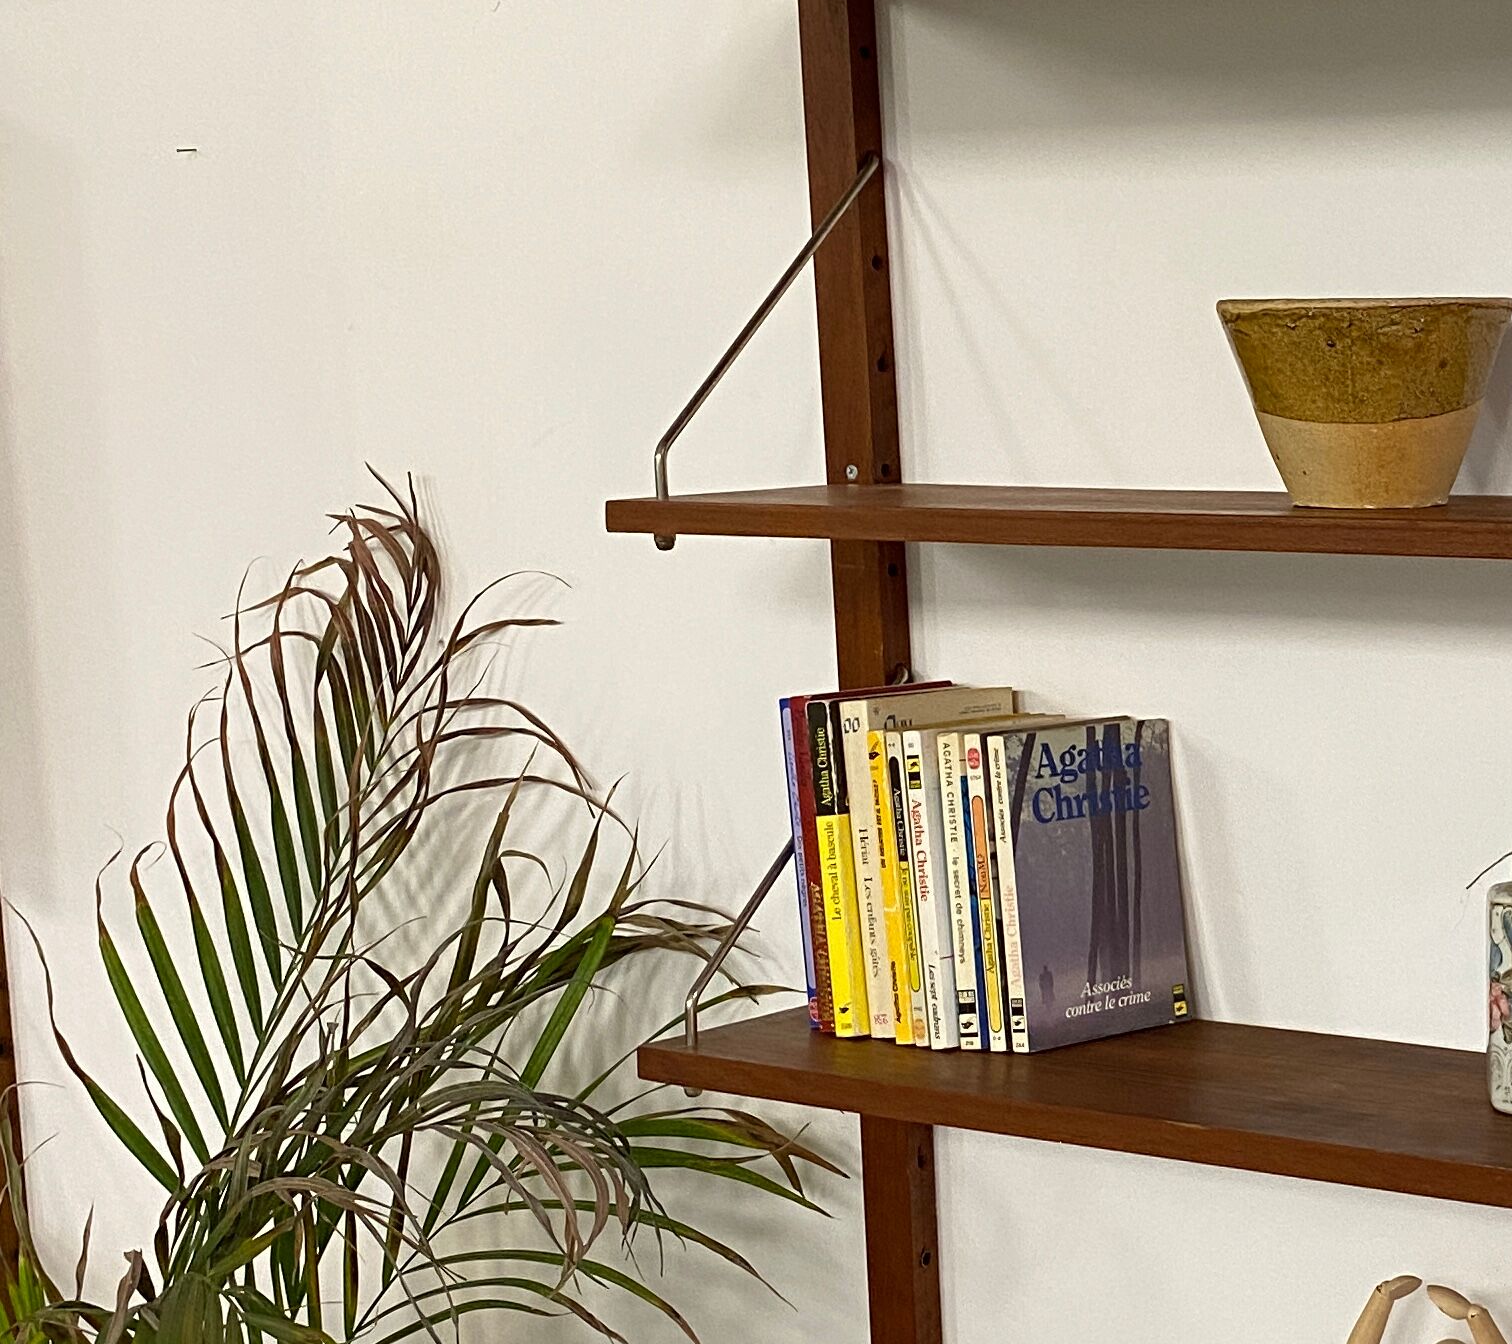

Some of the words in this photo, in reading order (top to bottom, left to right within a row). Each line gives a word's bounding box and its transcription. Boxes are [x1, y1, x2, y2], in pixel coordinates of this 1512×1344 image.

[817, 727, 829, 769] Christie
[942, 742, 954, 787] AGATHA
[1034, 739, 1143, 784] Agatha
[821, 771, 833, 807] Agatha
[893, 788, 904, 819] Agatha
[1031, 776, 1151, 824] Christie
[911, 798, 925, 846] Agatha
[946, 792, 958, 843] CHRISTIE
[824, 821, 837, 859] bascule
[898, 819, 907, 855] Christie
[828, 861, 837, 871] à
[916, 850, 930, 902] Christie
[951, 856, 960, 865] le
[830, 872, 841, 908] cheval
[863, 877, 873, 900] Les
[952, 870, 962, 900] secret
[832, 909, 842, 921] Le
[866, 902, 878, 945] enfants
[954, 903, 963, 916] de
[982, 904, 992, 941] Christie
[1004, 884, 1018, 937] Christie
[985, 944, 995, 974] Agatha
[1008, 941, 1022, 988] Agatha
[1065, 1000, 1102, 1018] contre
[1104, 997, 1116, 1011] le
[1118, 990, 1152, 1008] crime
[1080, 974, 1133, 998] Associés
